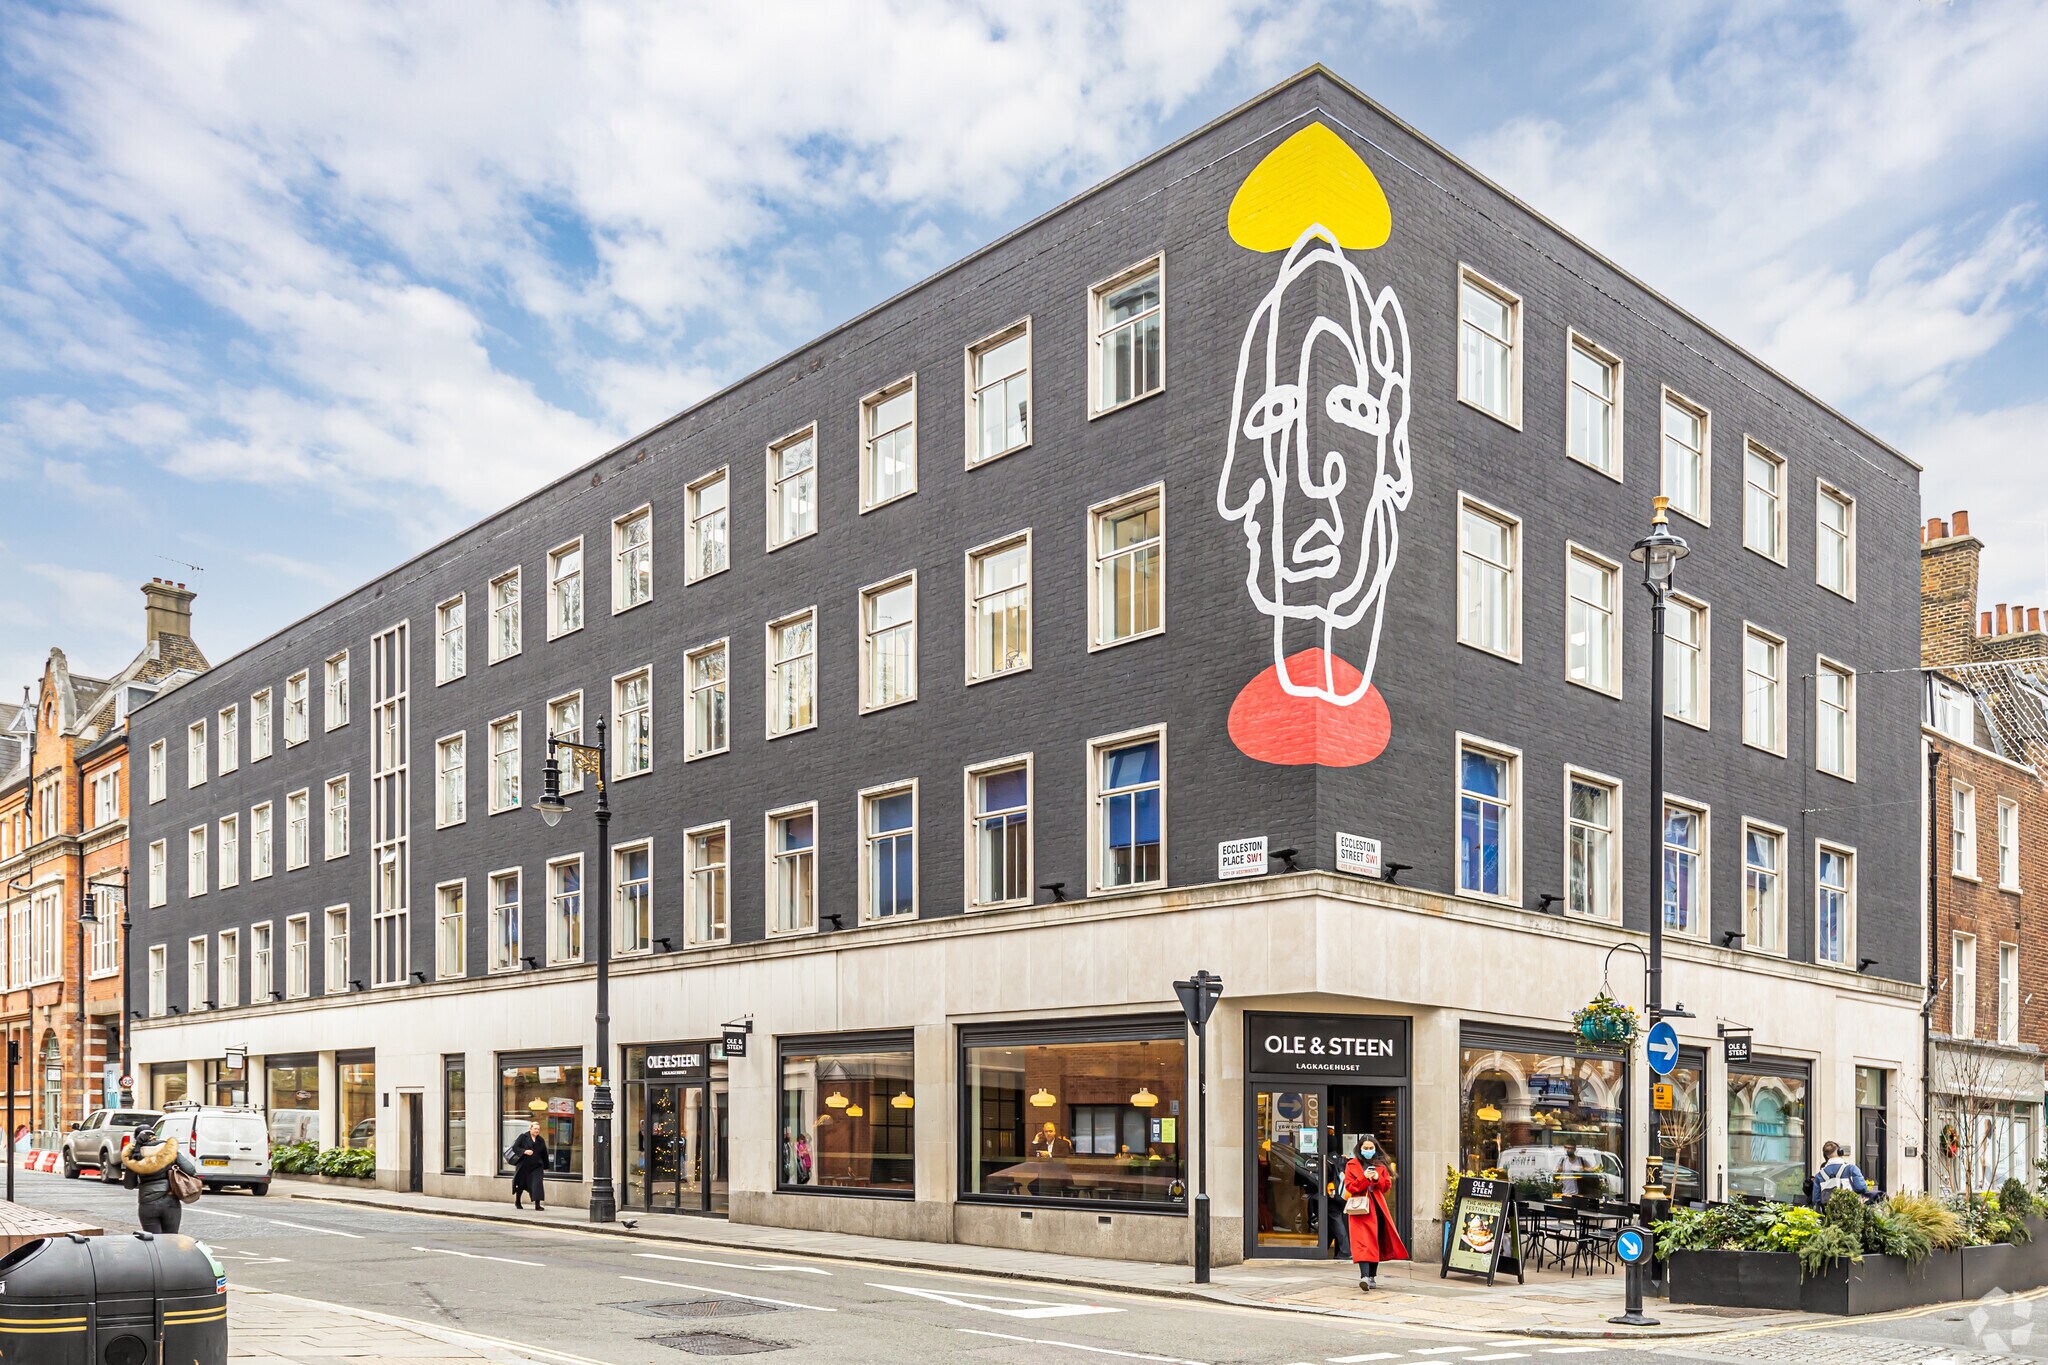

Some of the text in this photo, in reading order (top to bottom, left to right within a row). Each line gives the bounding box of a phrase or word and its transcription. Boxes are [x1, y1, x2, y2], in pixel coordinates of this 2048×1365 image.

[1222, 841, 1262, 855] ECCLESTON
[1341, 836, 1376, 853] ECCLESTON
[1222, 853, 1262, 866] PLACE SW1
[1341, 848, 1378, 865] STREET SW1
[1264, 1035, 1394, 1057] OLE & STEEN
[647, 1054, 698, 1069] OLE & STEEN
[1296, 1062, 1360, 1071] LAGKAGEHUSET
[1472, 1187, 1492, 1195] STEEN
